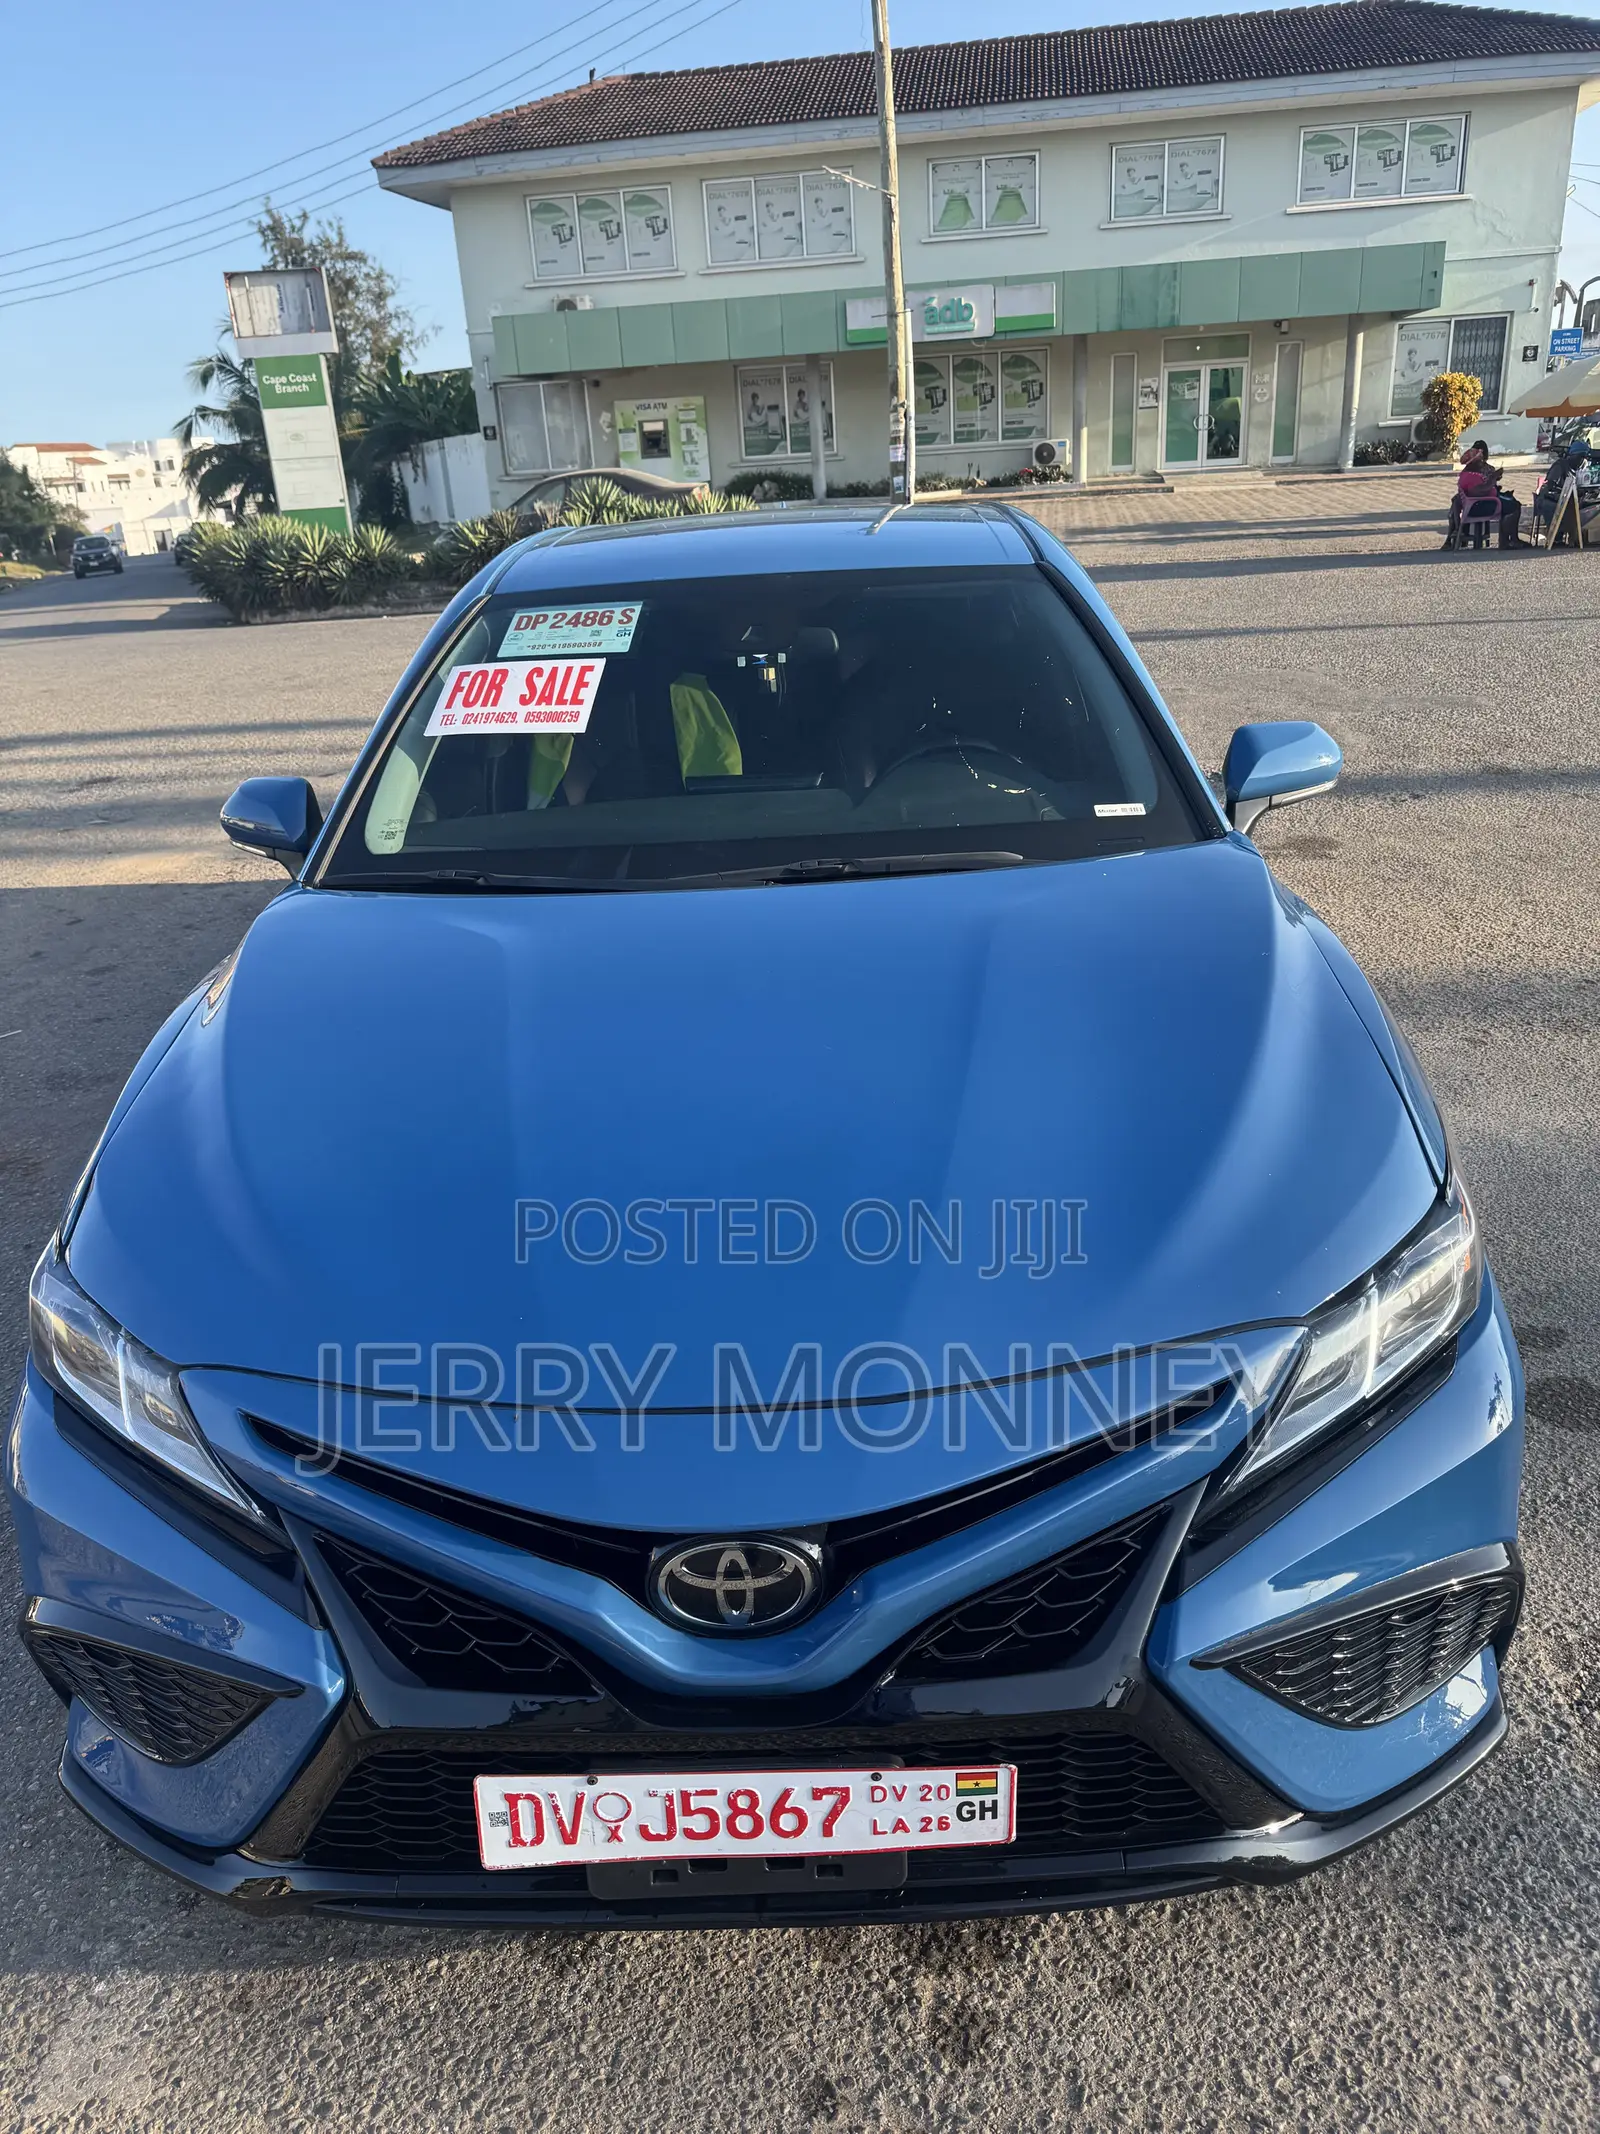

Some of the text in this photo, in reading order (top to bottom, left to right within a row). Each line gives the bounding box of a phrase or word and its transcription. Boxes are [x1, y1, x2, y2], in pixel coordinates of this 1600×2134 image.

[1400, 333, 1421, 341] DIAL
[262, 373, 318, 384] Cape Coast
[275, 383, 310, 394] Branch
[653, 402, 668, 411] ATM
[514, 608, 636, 631] DP 2486 S
[445, 665, 595, 710] FOR SALE
[440, 710, 580, 726] TEL: 0241974629, 0593000259
[870, 1783, 951, 1804] DV 20
[503, 1790, 588, 1848] DV
[638, 1786, 852, 1841] J5867
[956, 1799, 998, 1822] GH
[872, 1815, 951, 1836] LA 26
